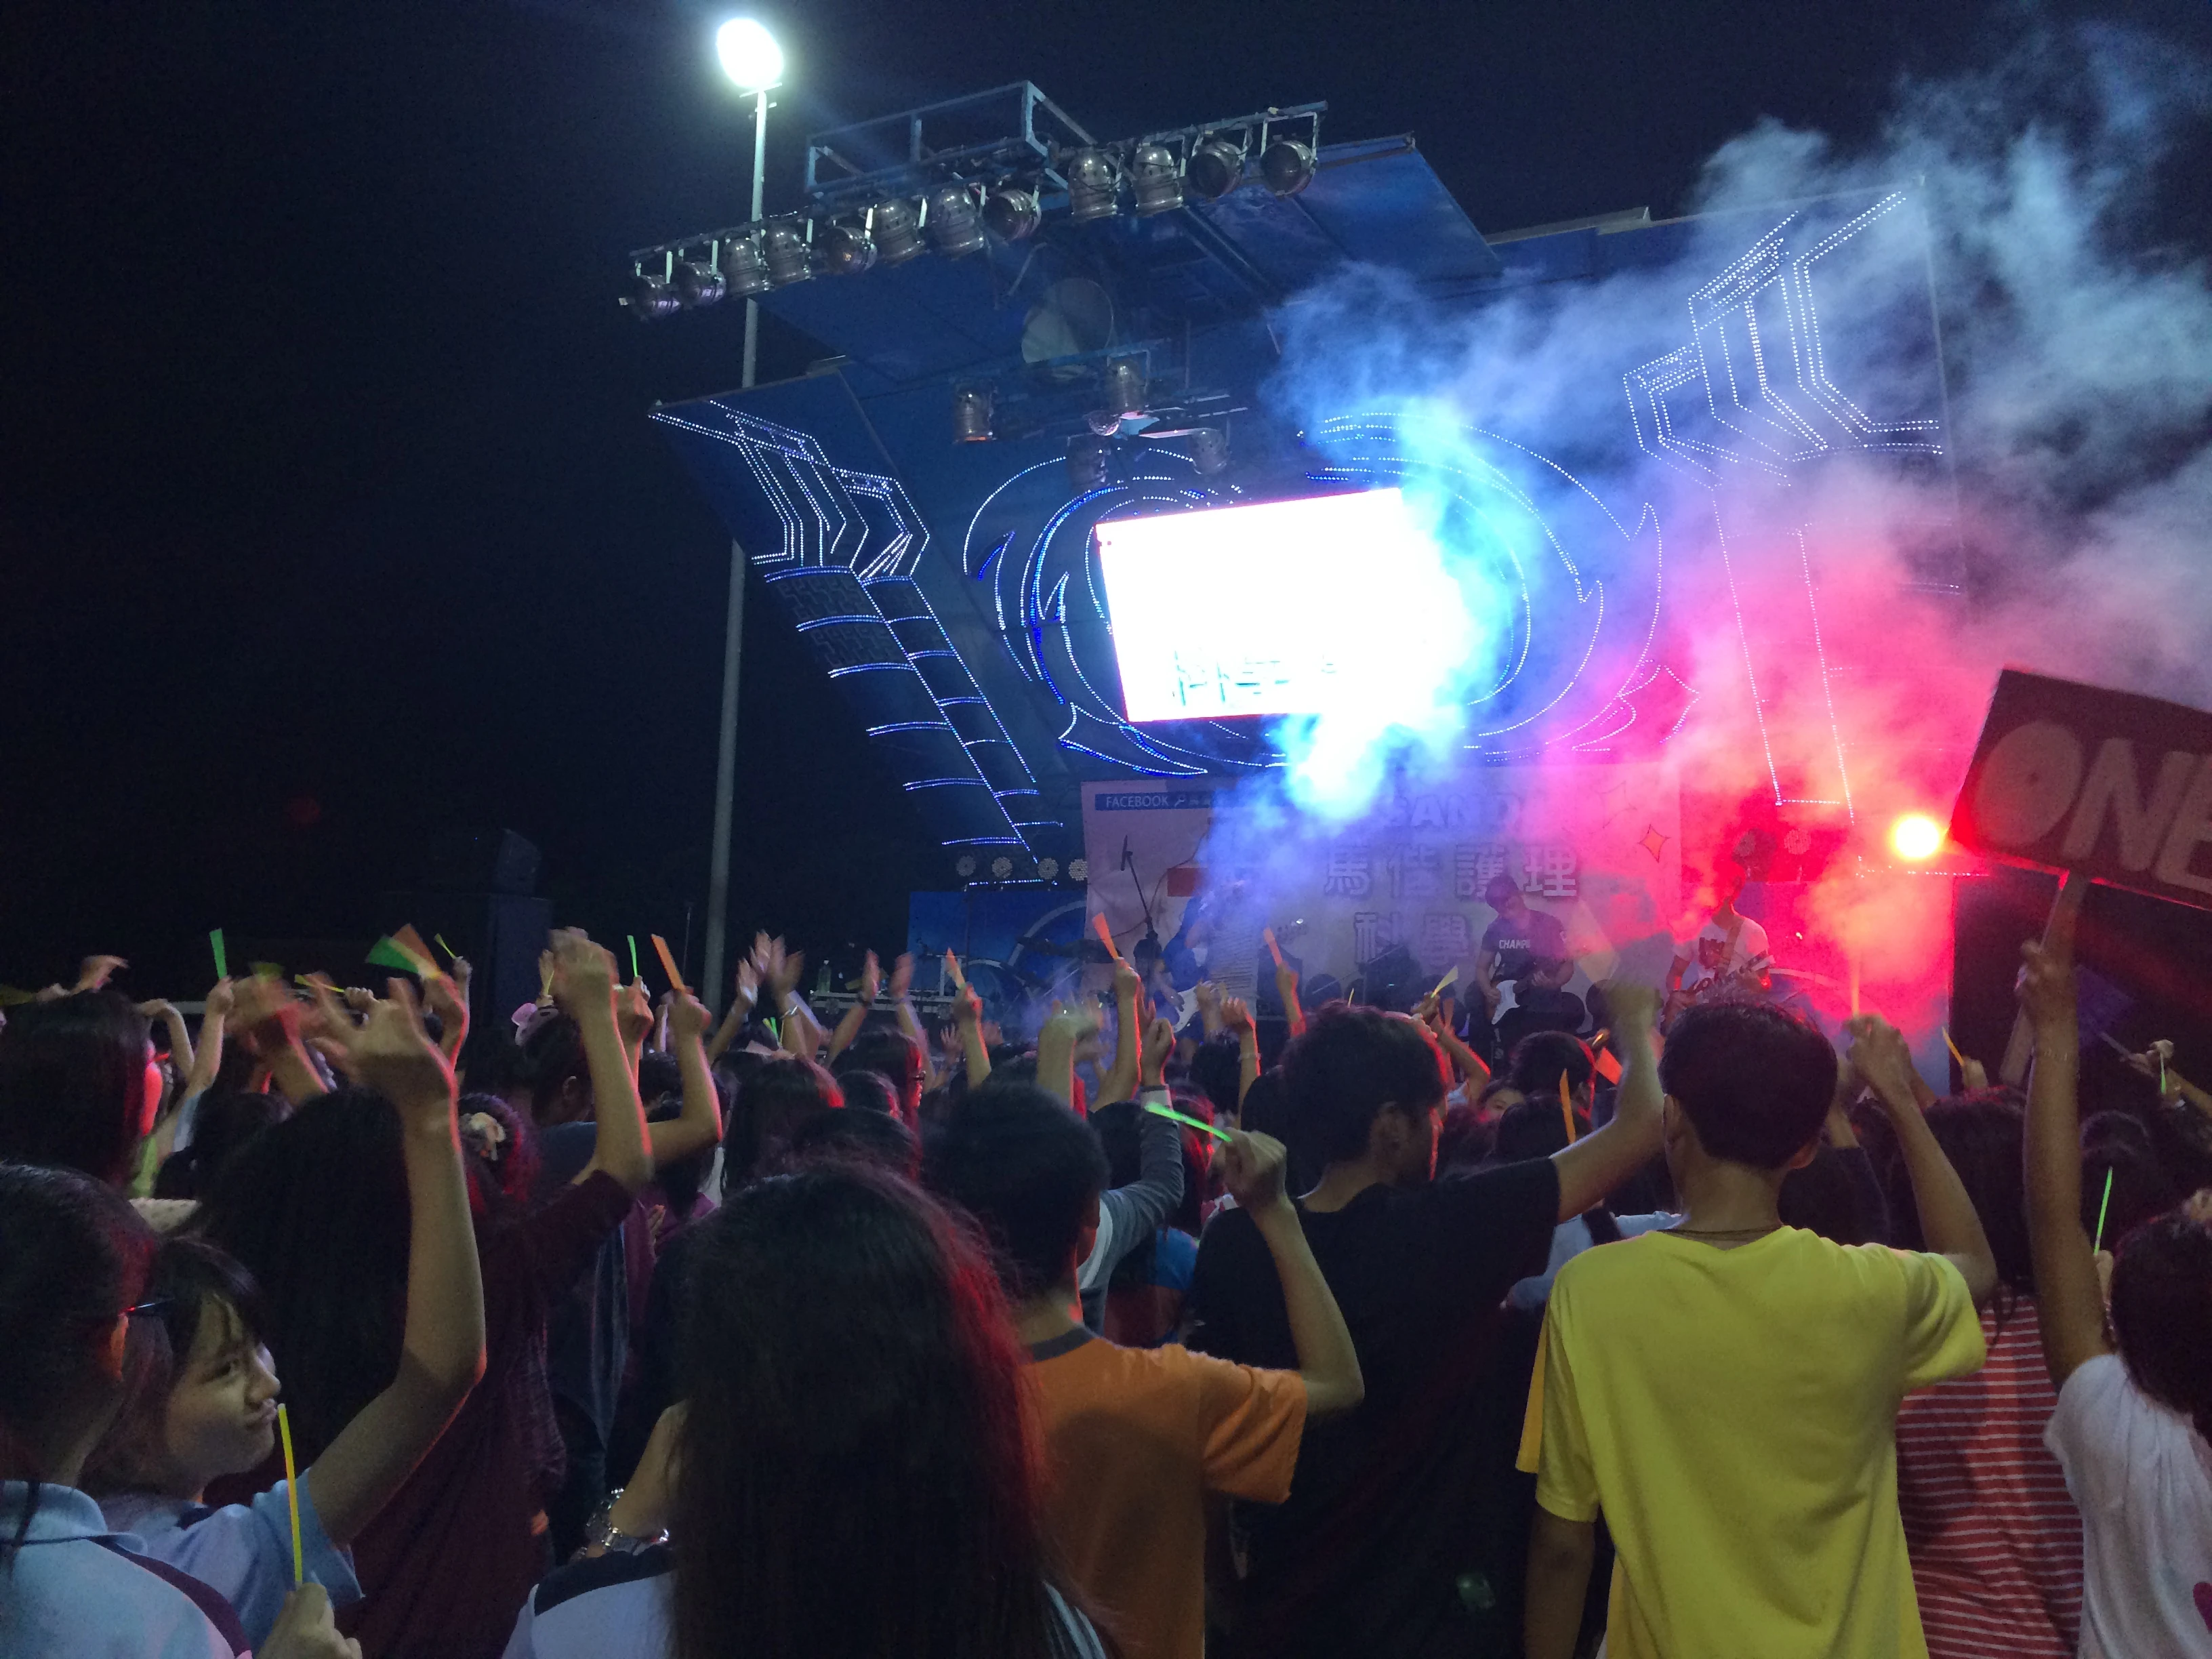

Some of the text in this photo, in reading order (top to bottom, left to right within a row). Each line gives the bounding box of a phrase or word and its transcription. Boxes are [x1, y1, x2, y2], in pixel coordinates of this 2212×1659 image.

[1105, 796, 1169, 807] FACEBOOK
[1324, 842, 1578, 899] 馬偕護理
